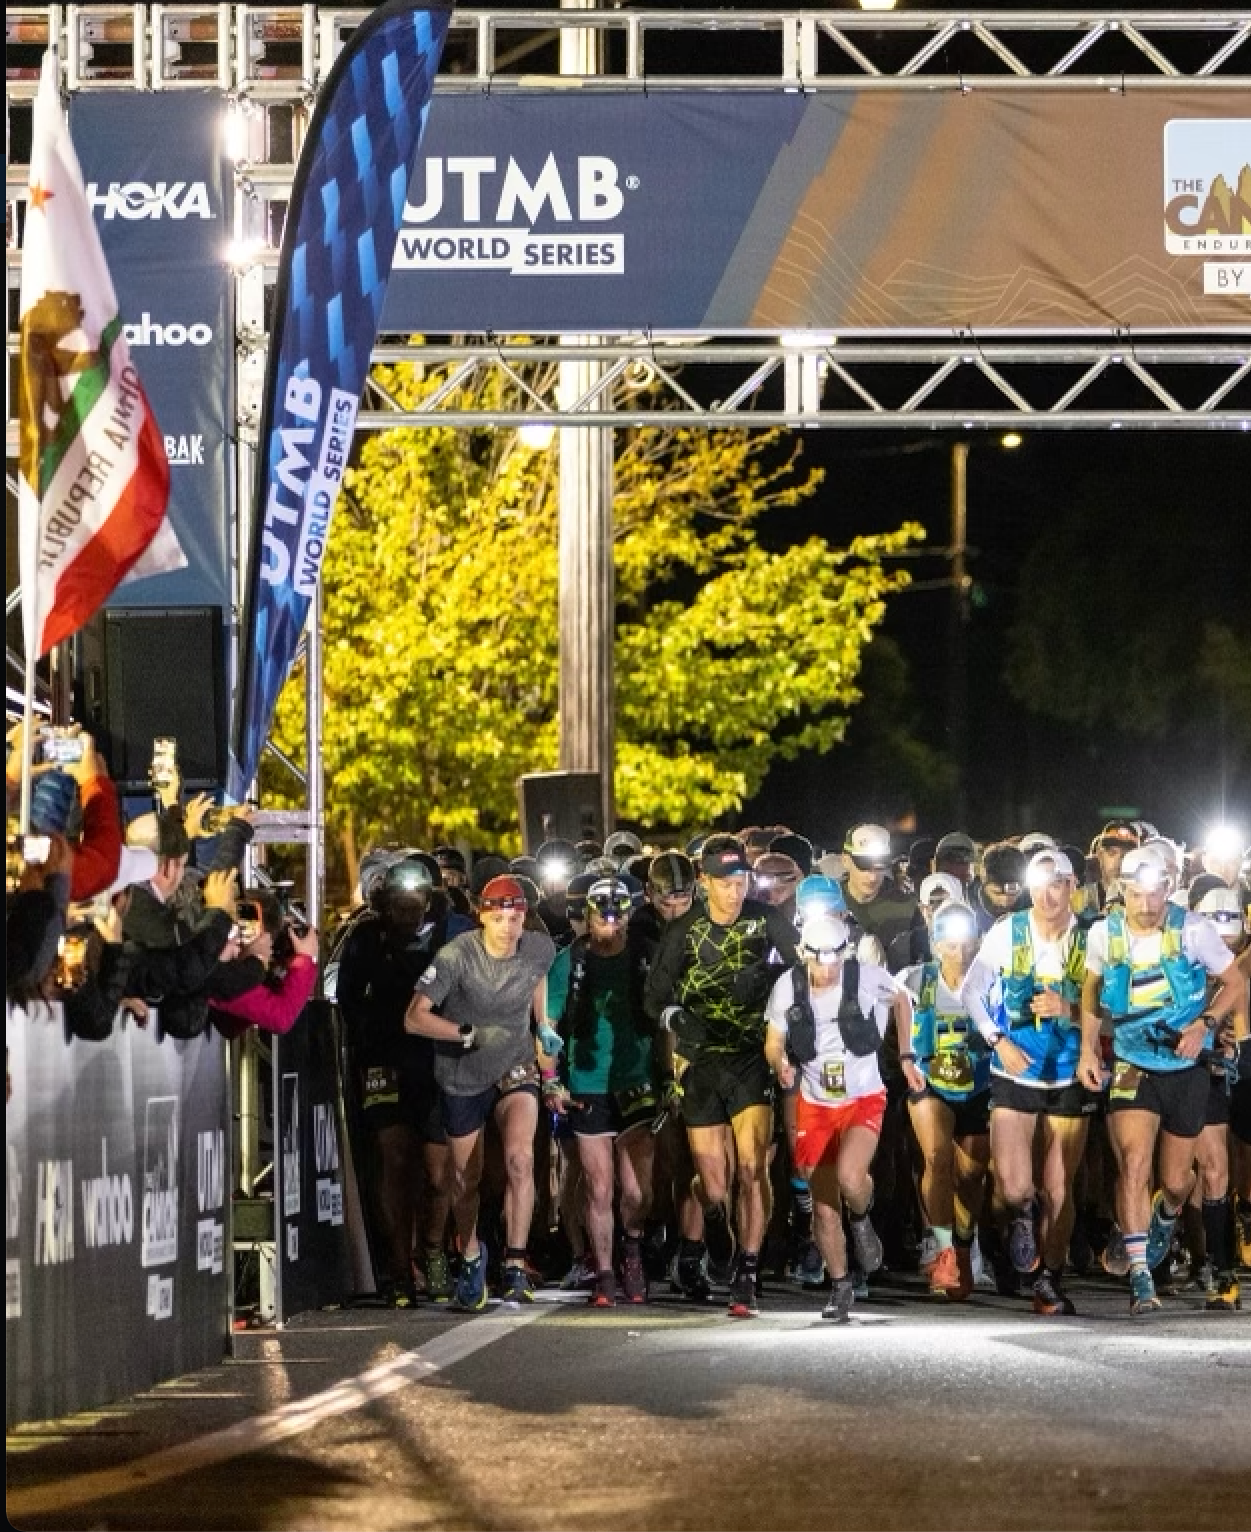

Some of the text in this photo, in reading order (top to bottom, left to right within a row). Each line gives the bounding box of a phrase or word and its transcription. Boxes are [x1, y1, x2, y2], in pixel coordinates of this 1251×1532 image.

[86, 182, 212, 220] HOKA
[1172, 179, 1204, 193] THE
[402, 237, 616, 266] WORLD SERIES
[1217, 268, 1245, 287] BY
[260, 374, 323, 586] UTMB
[300, 398, 353, 586] WORLD SERIES
[82, 1137, 133, 1248] wahoo
